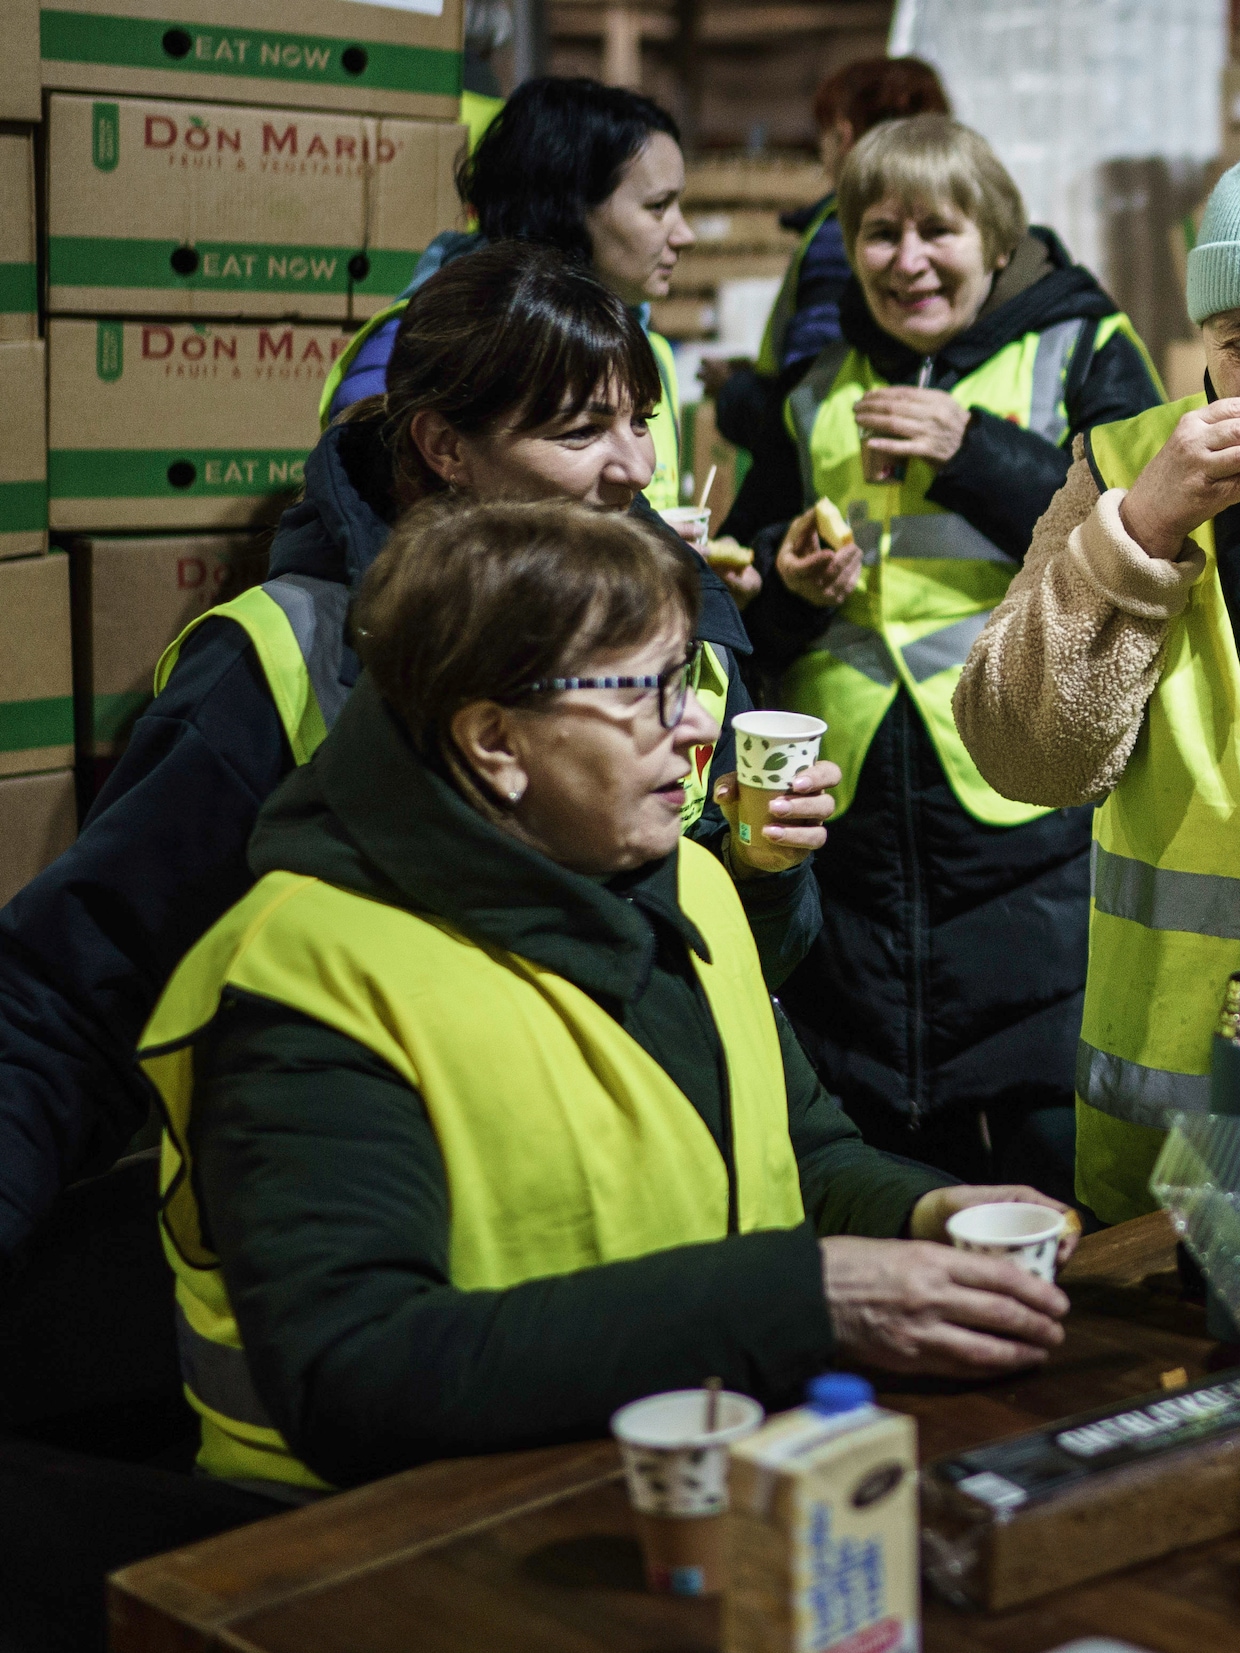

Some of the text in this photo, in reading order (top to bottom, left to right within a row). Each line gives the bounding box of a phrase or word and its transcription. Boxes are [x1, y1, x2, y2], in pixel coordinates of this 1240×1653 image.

[195, 35, 331, 71] EAT NOW
[203, 253, 337, 281] EAT NOW
[205, 460, 258, 484] EAT
